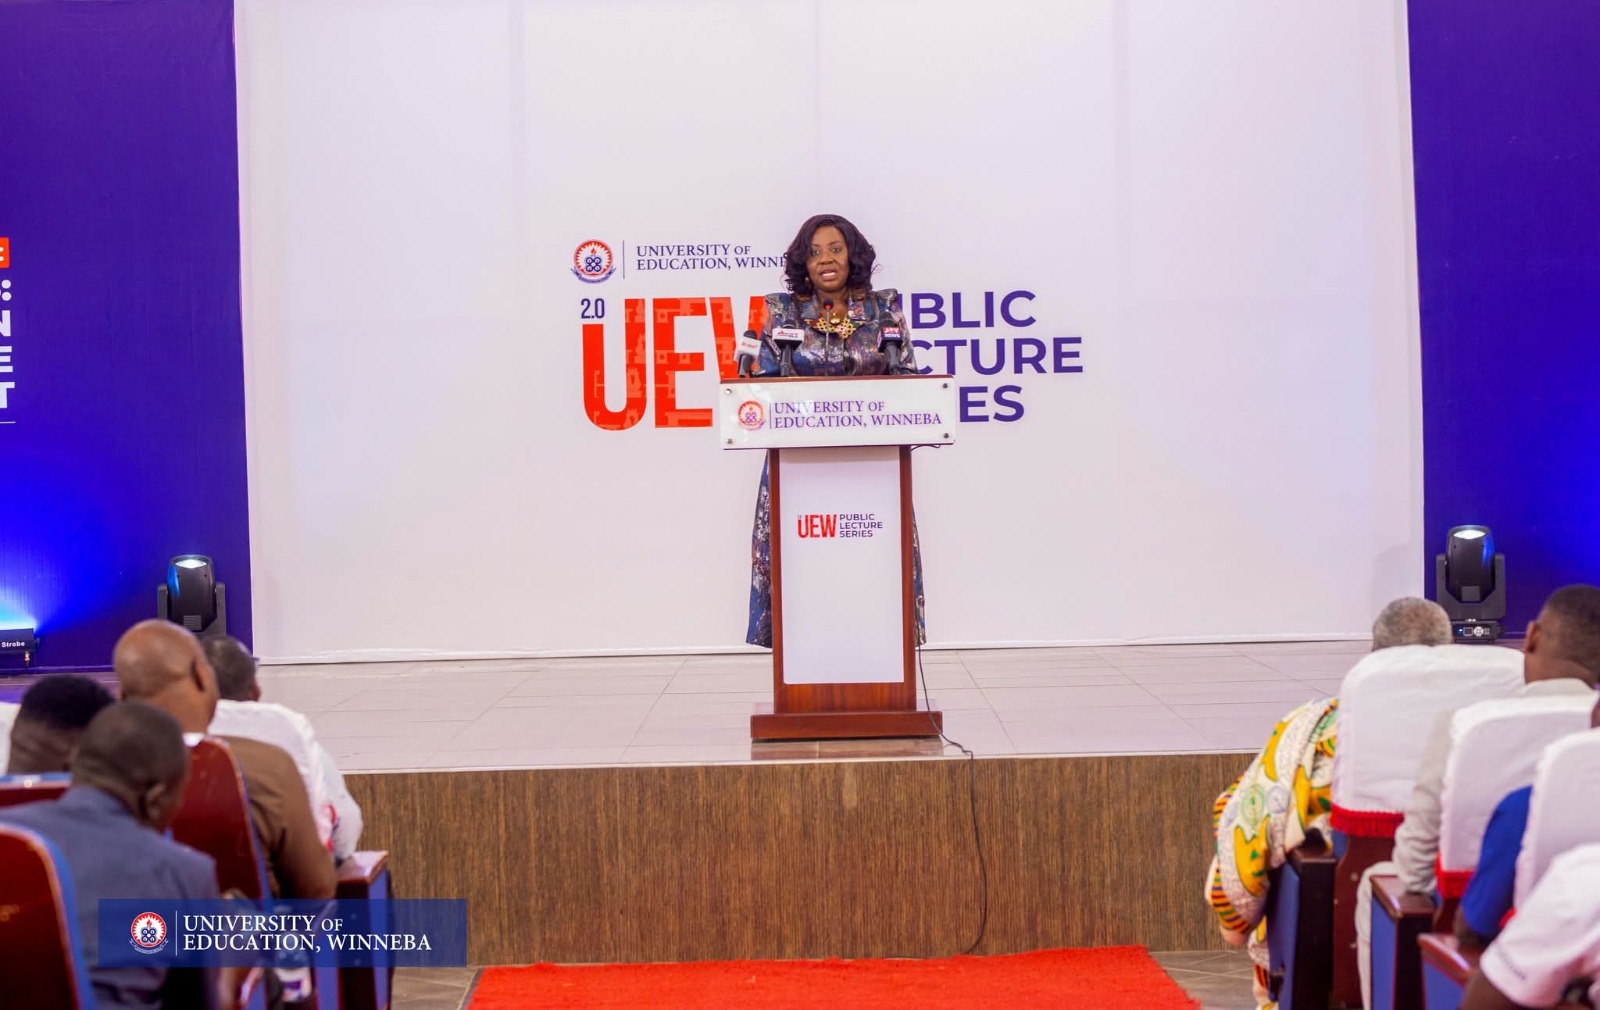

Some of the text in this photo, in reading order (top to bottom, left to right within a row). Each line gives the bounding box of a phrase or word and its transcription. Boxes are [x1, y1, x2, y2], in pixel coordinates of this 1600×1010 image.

[636, 243, 752, 257] UNIVERSITY OF
[636, 255, 787, 271] EDUCATION, WINNE
[580, 298, 606, 319] 2.0
[897, 289, 1037, 330] BLIC
[910, 336, 1084, 376] CTURE
[774, 400, 886, 415] UNIVERSITY OF
[958, 384, 1025, 423] ES
[774, 412, 942, 429] EDUCATION, WINNEBA
[839, 513, 875, 521] PUBLIC
[839, 521, 883, 529] LECTURE
[798, 514, 837, 538] UEW
[839, 530, 874, 538] SERIES
[1, 640, 26, 648] Strobe
